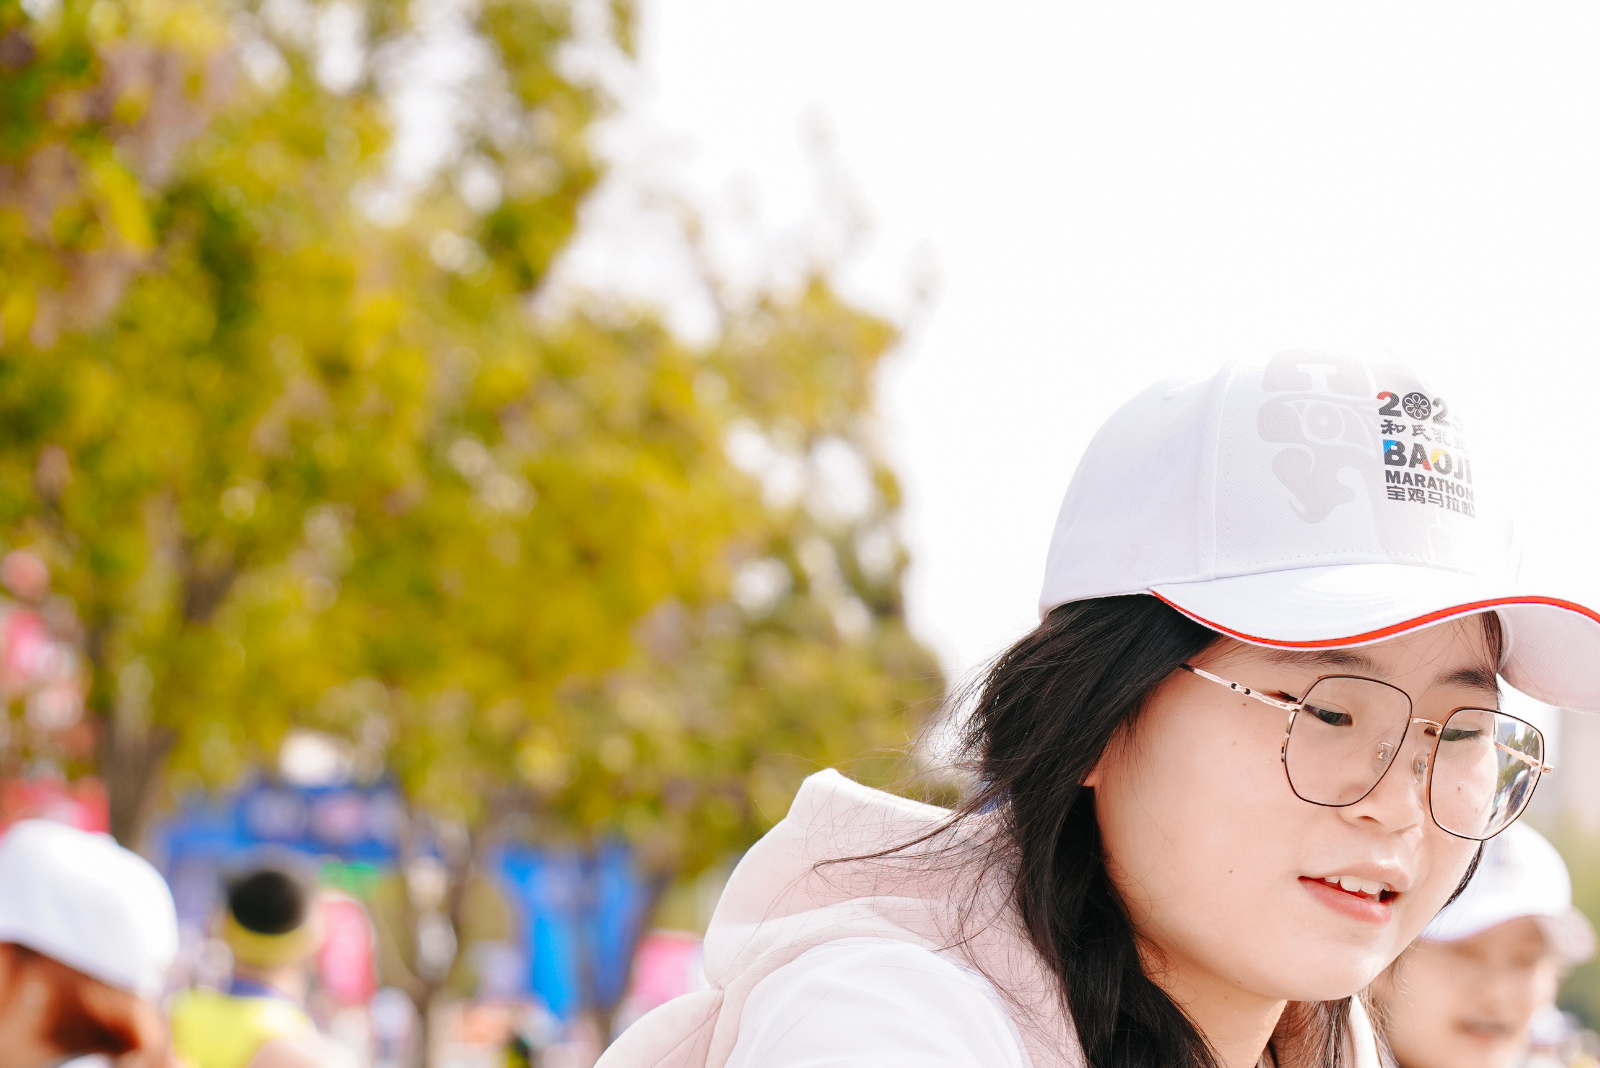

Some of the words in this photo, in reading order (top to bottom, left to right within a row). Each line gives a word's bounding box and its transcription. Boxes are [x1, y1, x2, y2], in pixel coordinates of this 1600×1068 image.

[1382, 438, 1473, 485] BAOJI
[1385, 469, 1475, 503] MARATHON
[1386, 485, 1476, 519] 宝鸡马拉松
